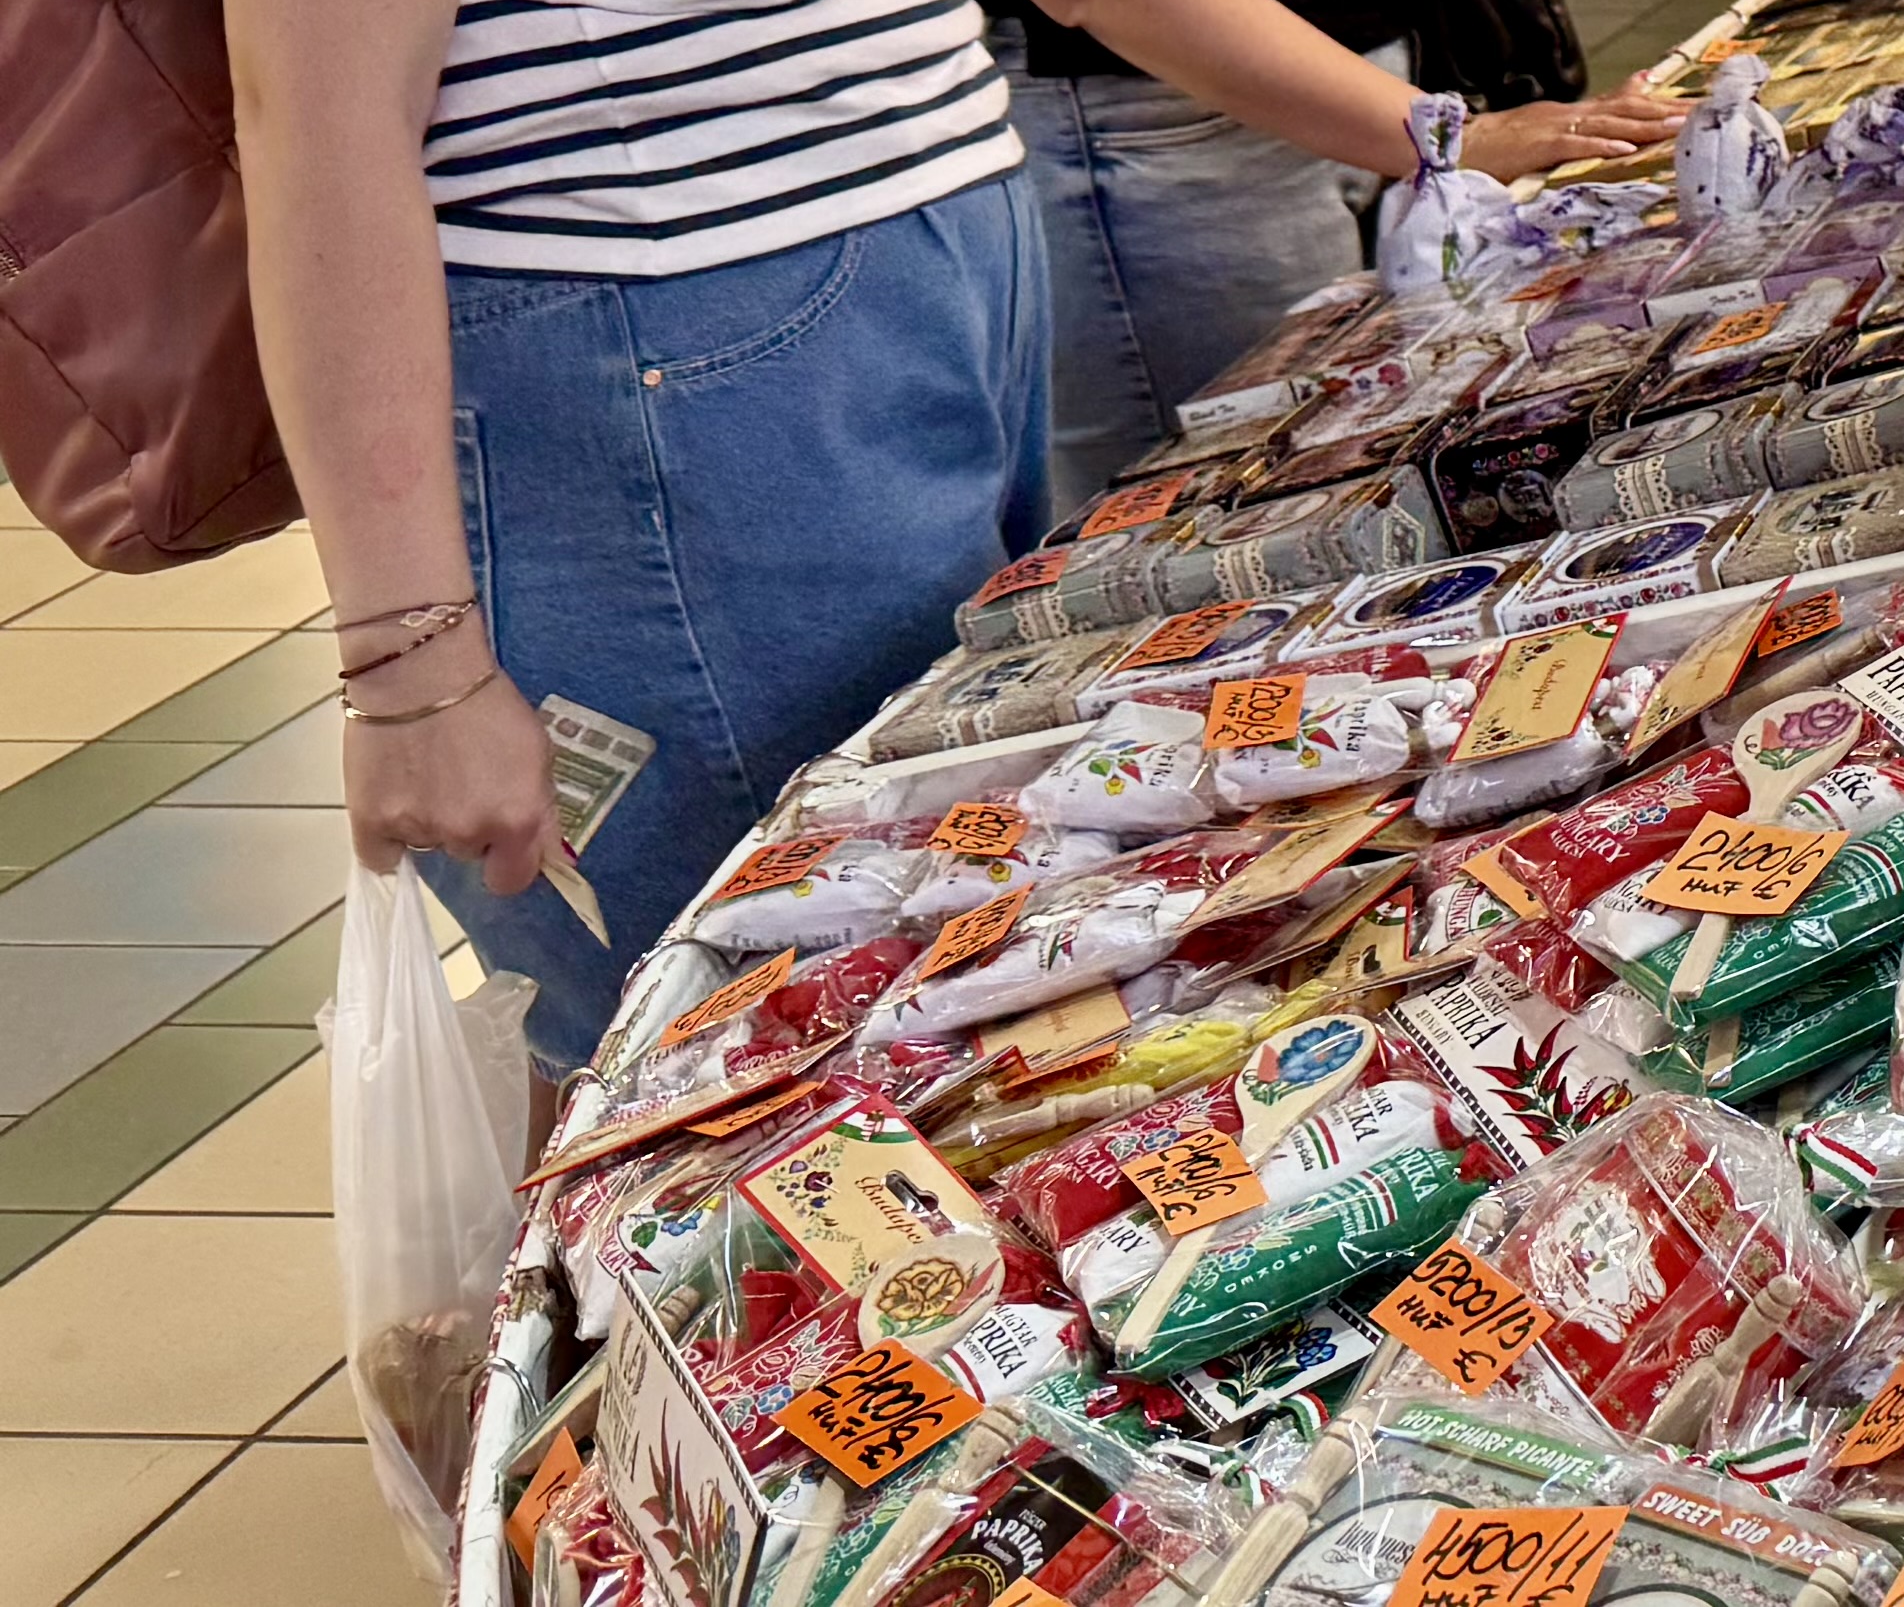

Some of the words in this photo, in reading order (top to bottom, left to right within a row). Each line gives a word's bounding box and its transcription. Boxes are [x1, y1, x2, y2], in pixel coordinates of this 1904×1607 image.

[1676, 828, 1825, 894] 2400/6
[1426, 973, 1508, 1051] PAPRIKA
[1224, 1243, 1318, 1295] SMOKED
[1397, 1407, 1442, 1432] HOT
[1439, 1417, 1514, 1459] SCHARF
[1507, 1437, 1597, 1480] PICANTE
[1642, 1490, 1720, 1529] SWEET
[970, 1518, 1047, 1577] PAPRIKA
[1421, 1511, 1614, 1602] 4500/11
